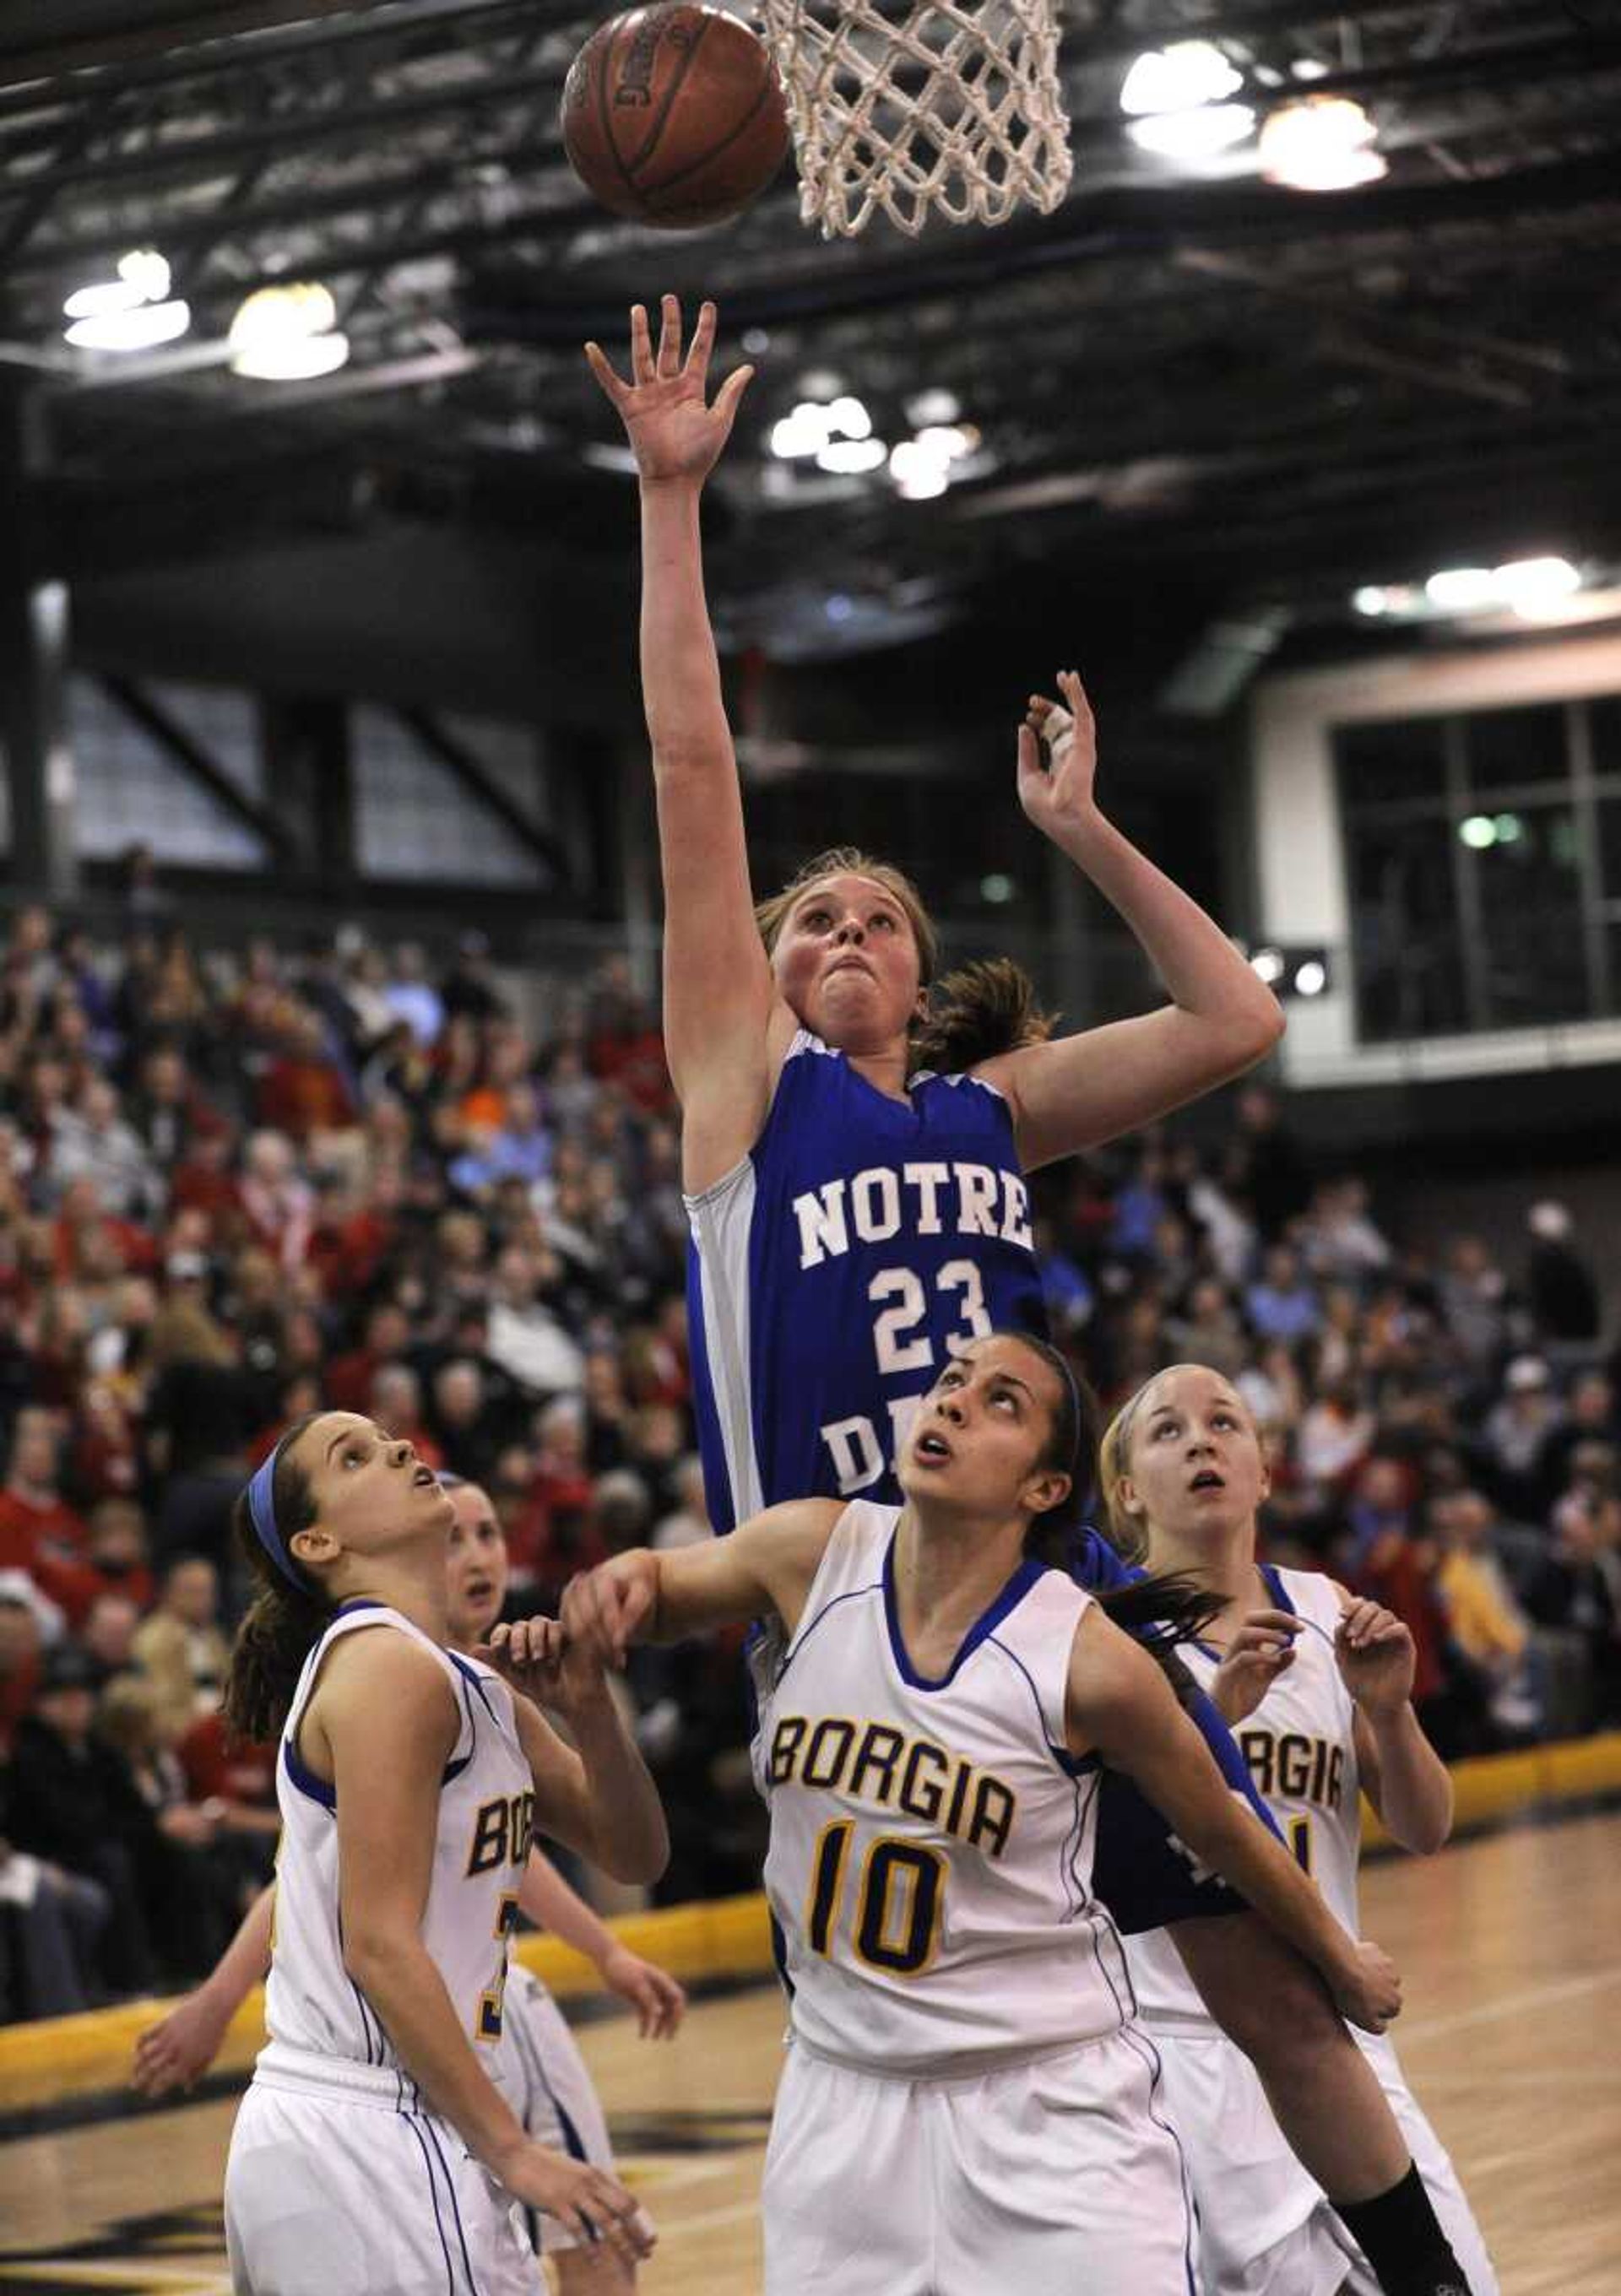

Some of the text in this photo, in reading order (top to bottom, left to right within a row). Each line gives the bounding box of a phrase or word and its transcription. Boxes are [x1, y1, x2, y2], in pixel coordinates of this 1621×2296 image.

[792, 1162, 1034, 1270] NOTRE
[868, 1259, 994, 1376] 23
[765, 1716, 1016, 1862] BORGIA
[808, 1817, 951, 1976] 10
